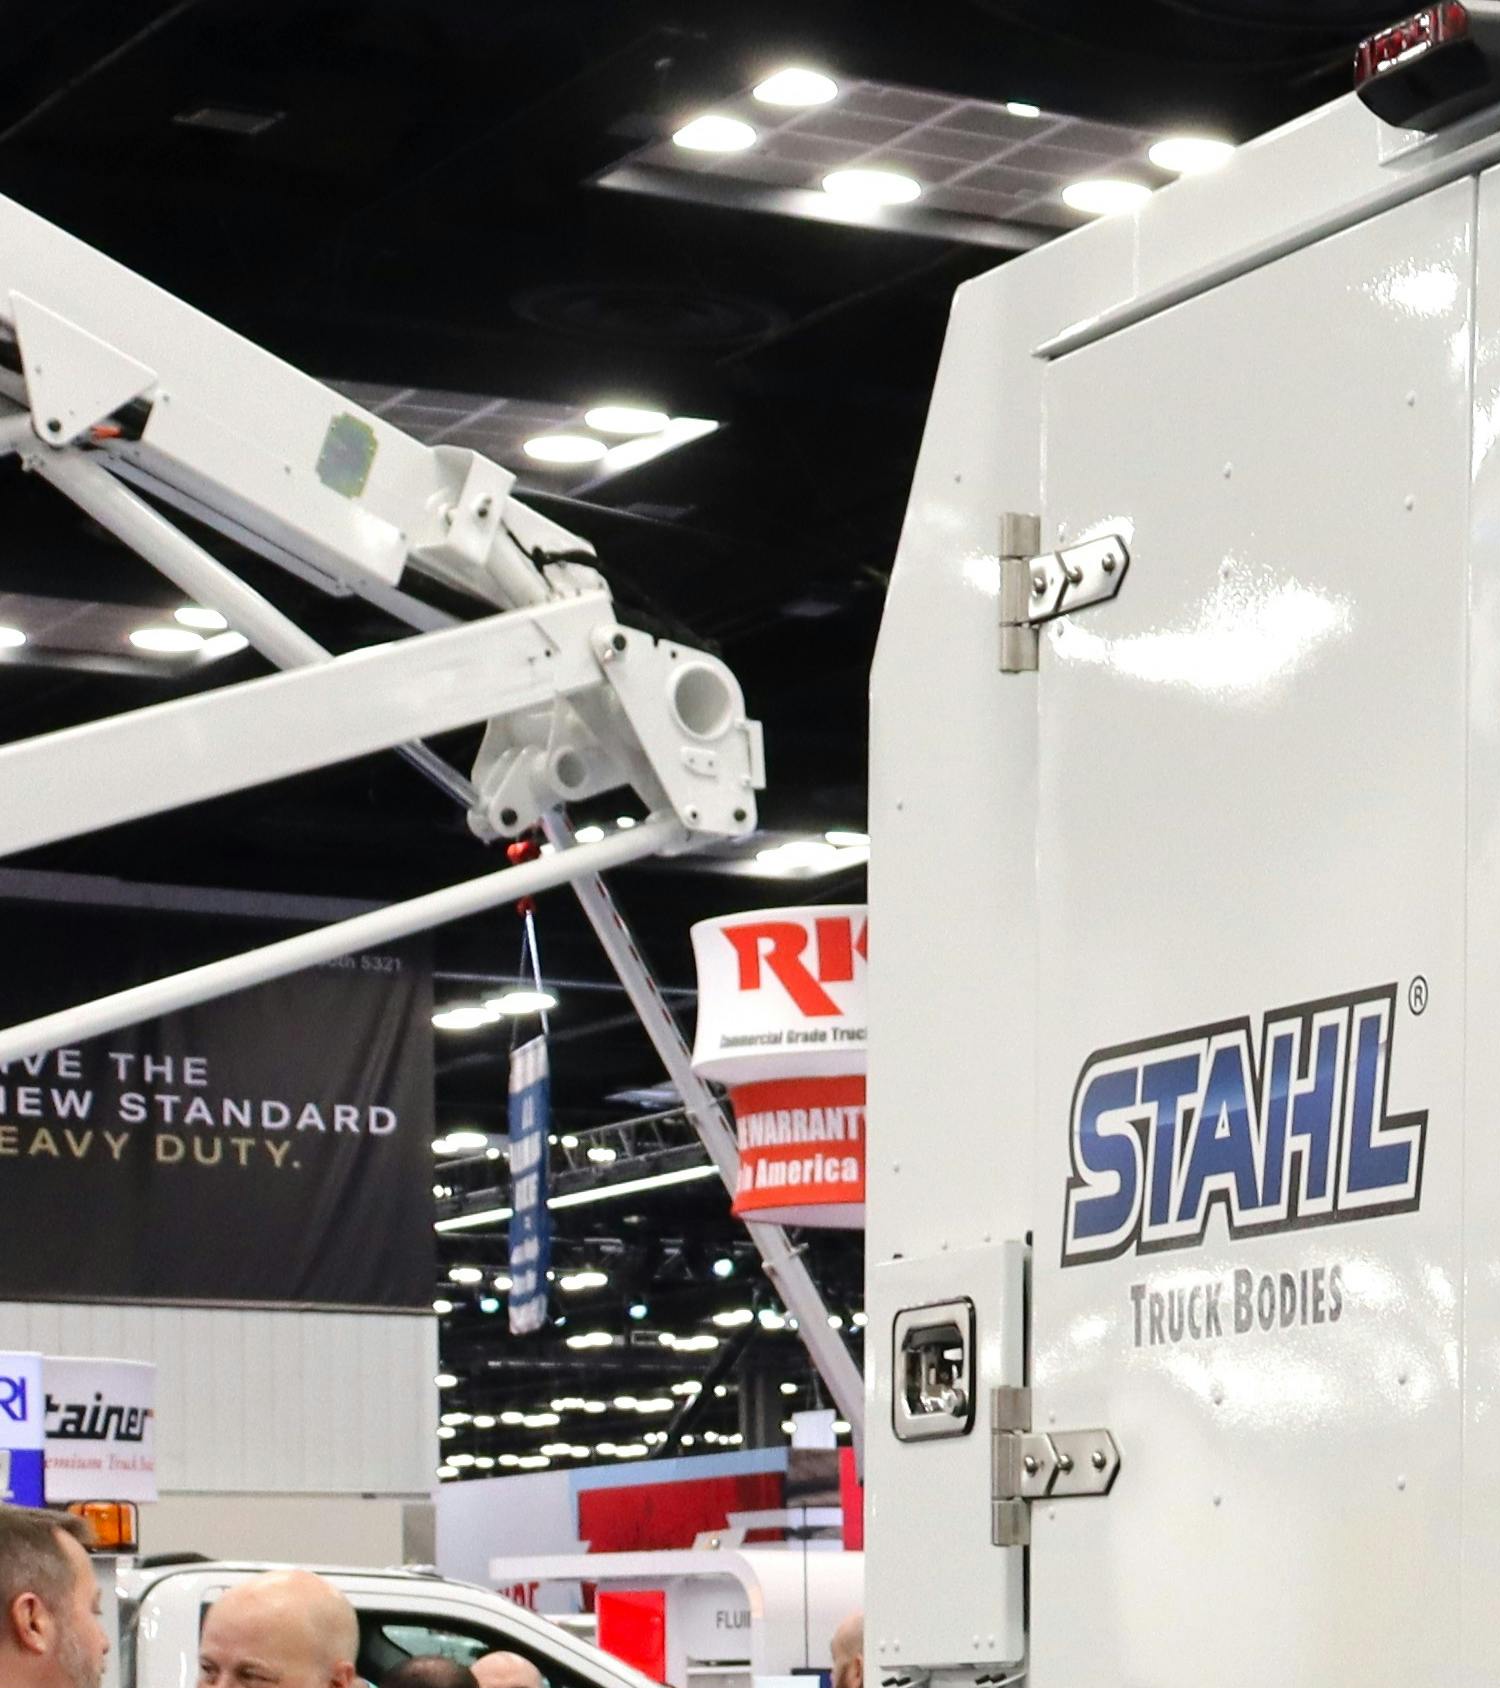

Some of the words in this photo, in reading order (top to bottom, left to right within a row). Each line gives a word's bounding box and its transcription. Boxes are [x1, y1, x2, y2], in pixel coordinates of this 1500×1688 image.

[787, 1028, 827, 1044] Grade
[110, 1051, 209, 1087] THE
[119, 1092, 398, 1136] STANDARD
[748, 1105, 866, 1149] WARRANT
[1061, 982, 1429, 1268] STAHL
[156, 1132, 301, 1169] DUTY.
[755, 1153, 859, 1189] America
[1130, 1283, 1223, 1348] TRUCK
[1234, 1264, 1344, 1335] BODIES
